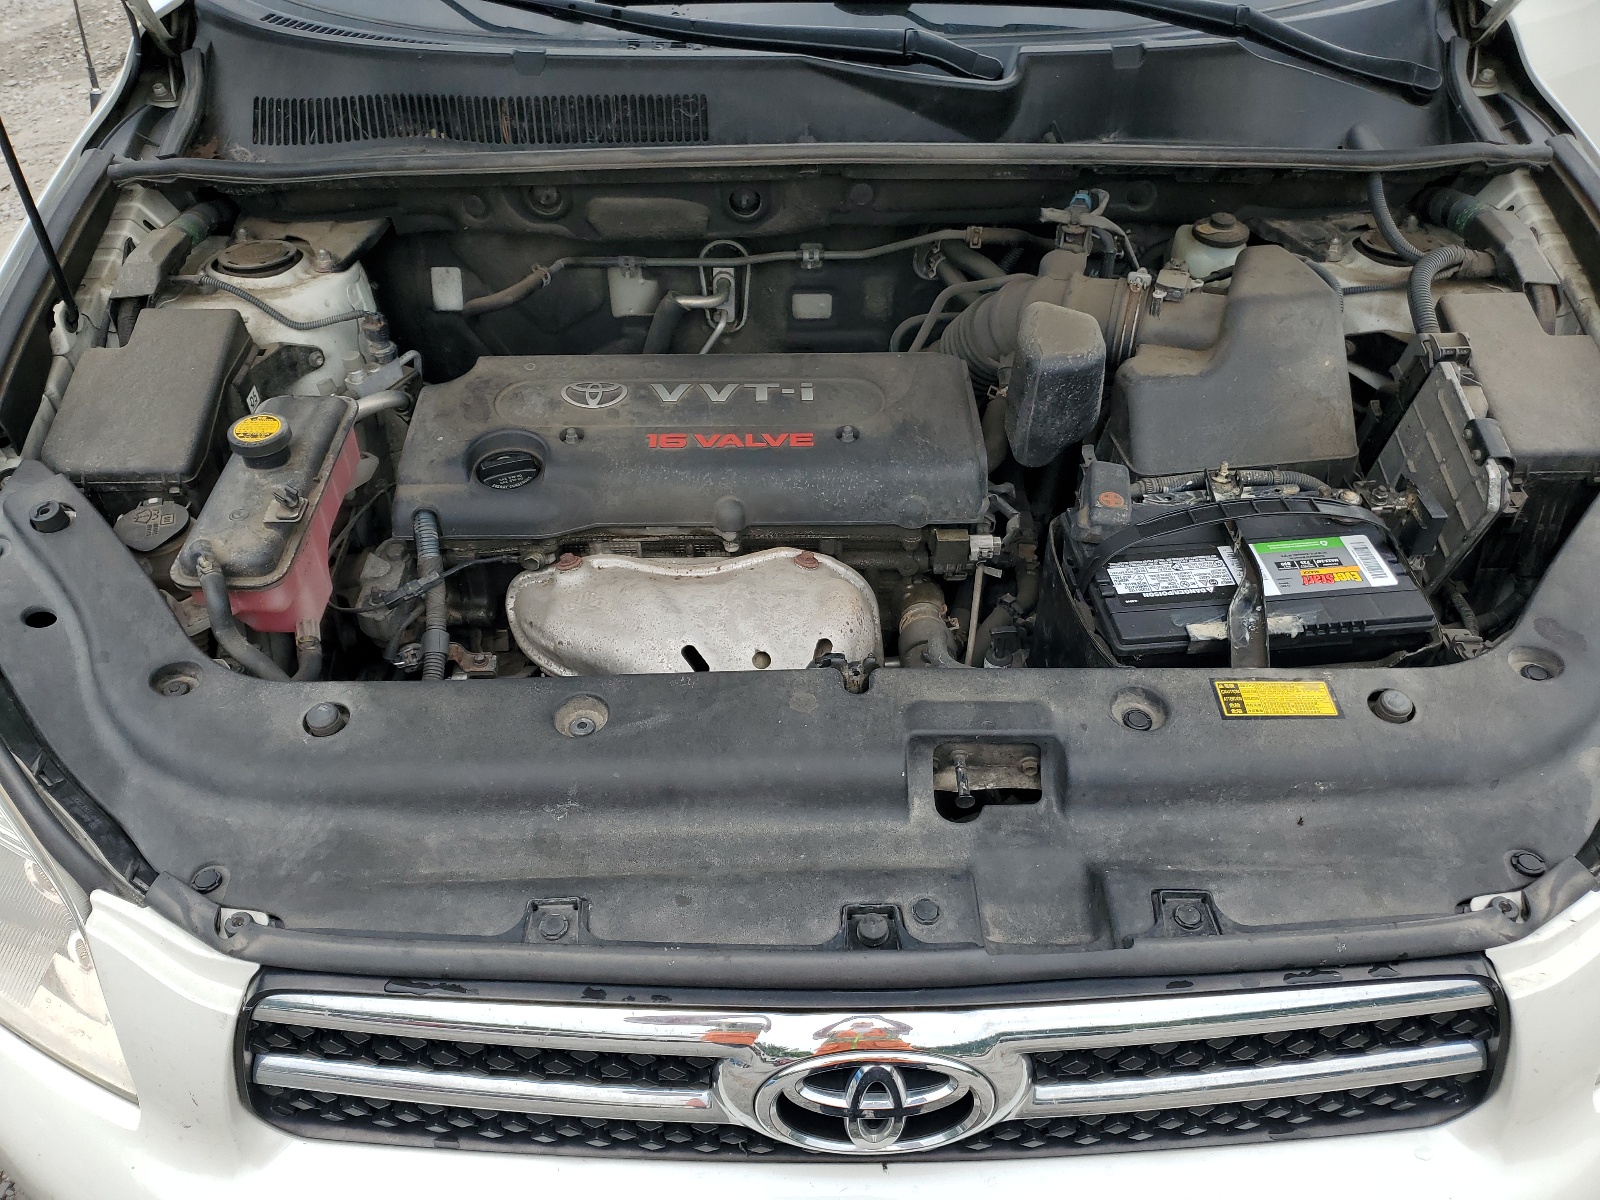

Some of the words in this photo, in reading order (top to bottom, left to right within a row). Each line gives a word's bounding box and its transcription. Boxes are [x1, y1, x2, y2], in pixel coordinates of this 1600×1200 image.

[650, 383, 814, 402] VVT-i
[646, 433, 687, 449] 16
[693, 433, 815, 449] VALVE
[1302, 571, 1362, 586] EverStart
